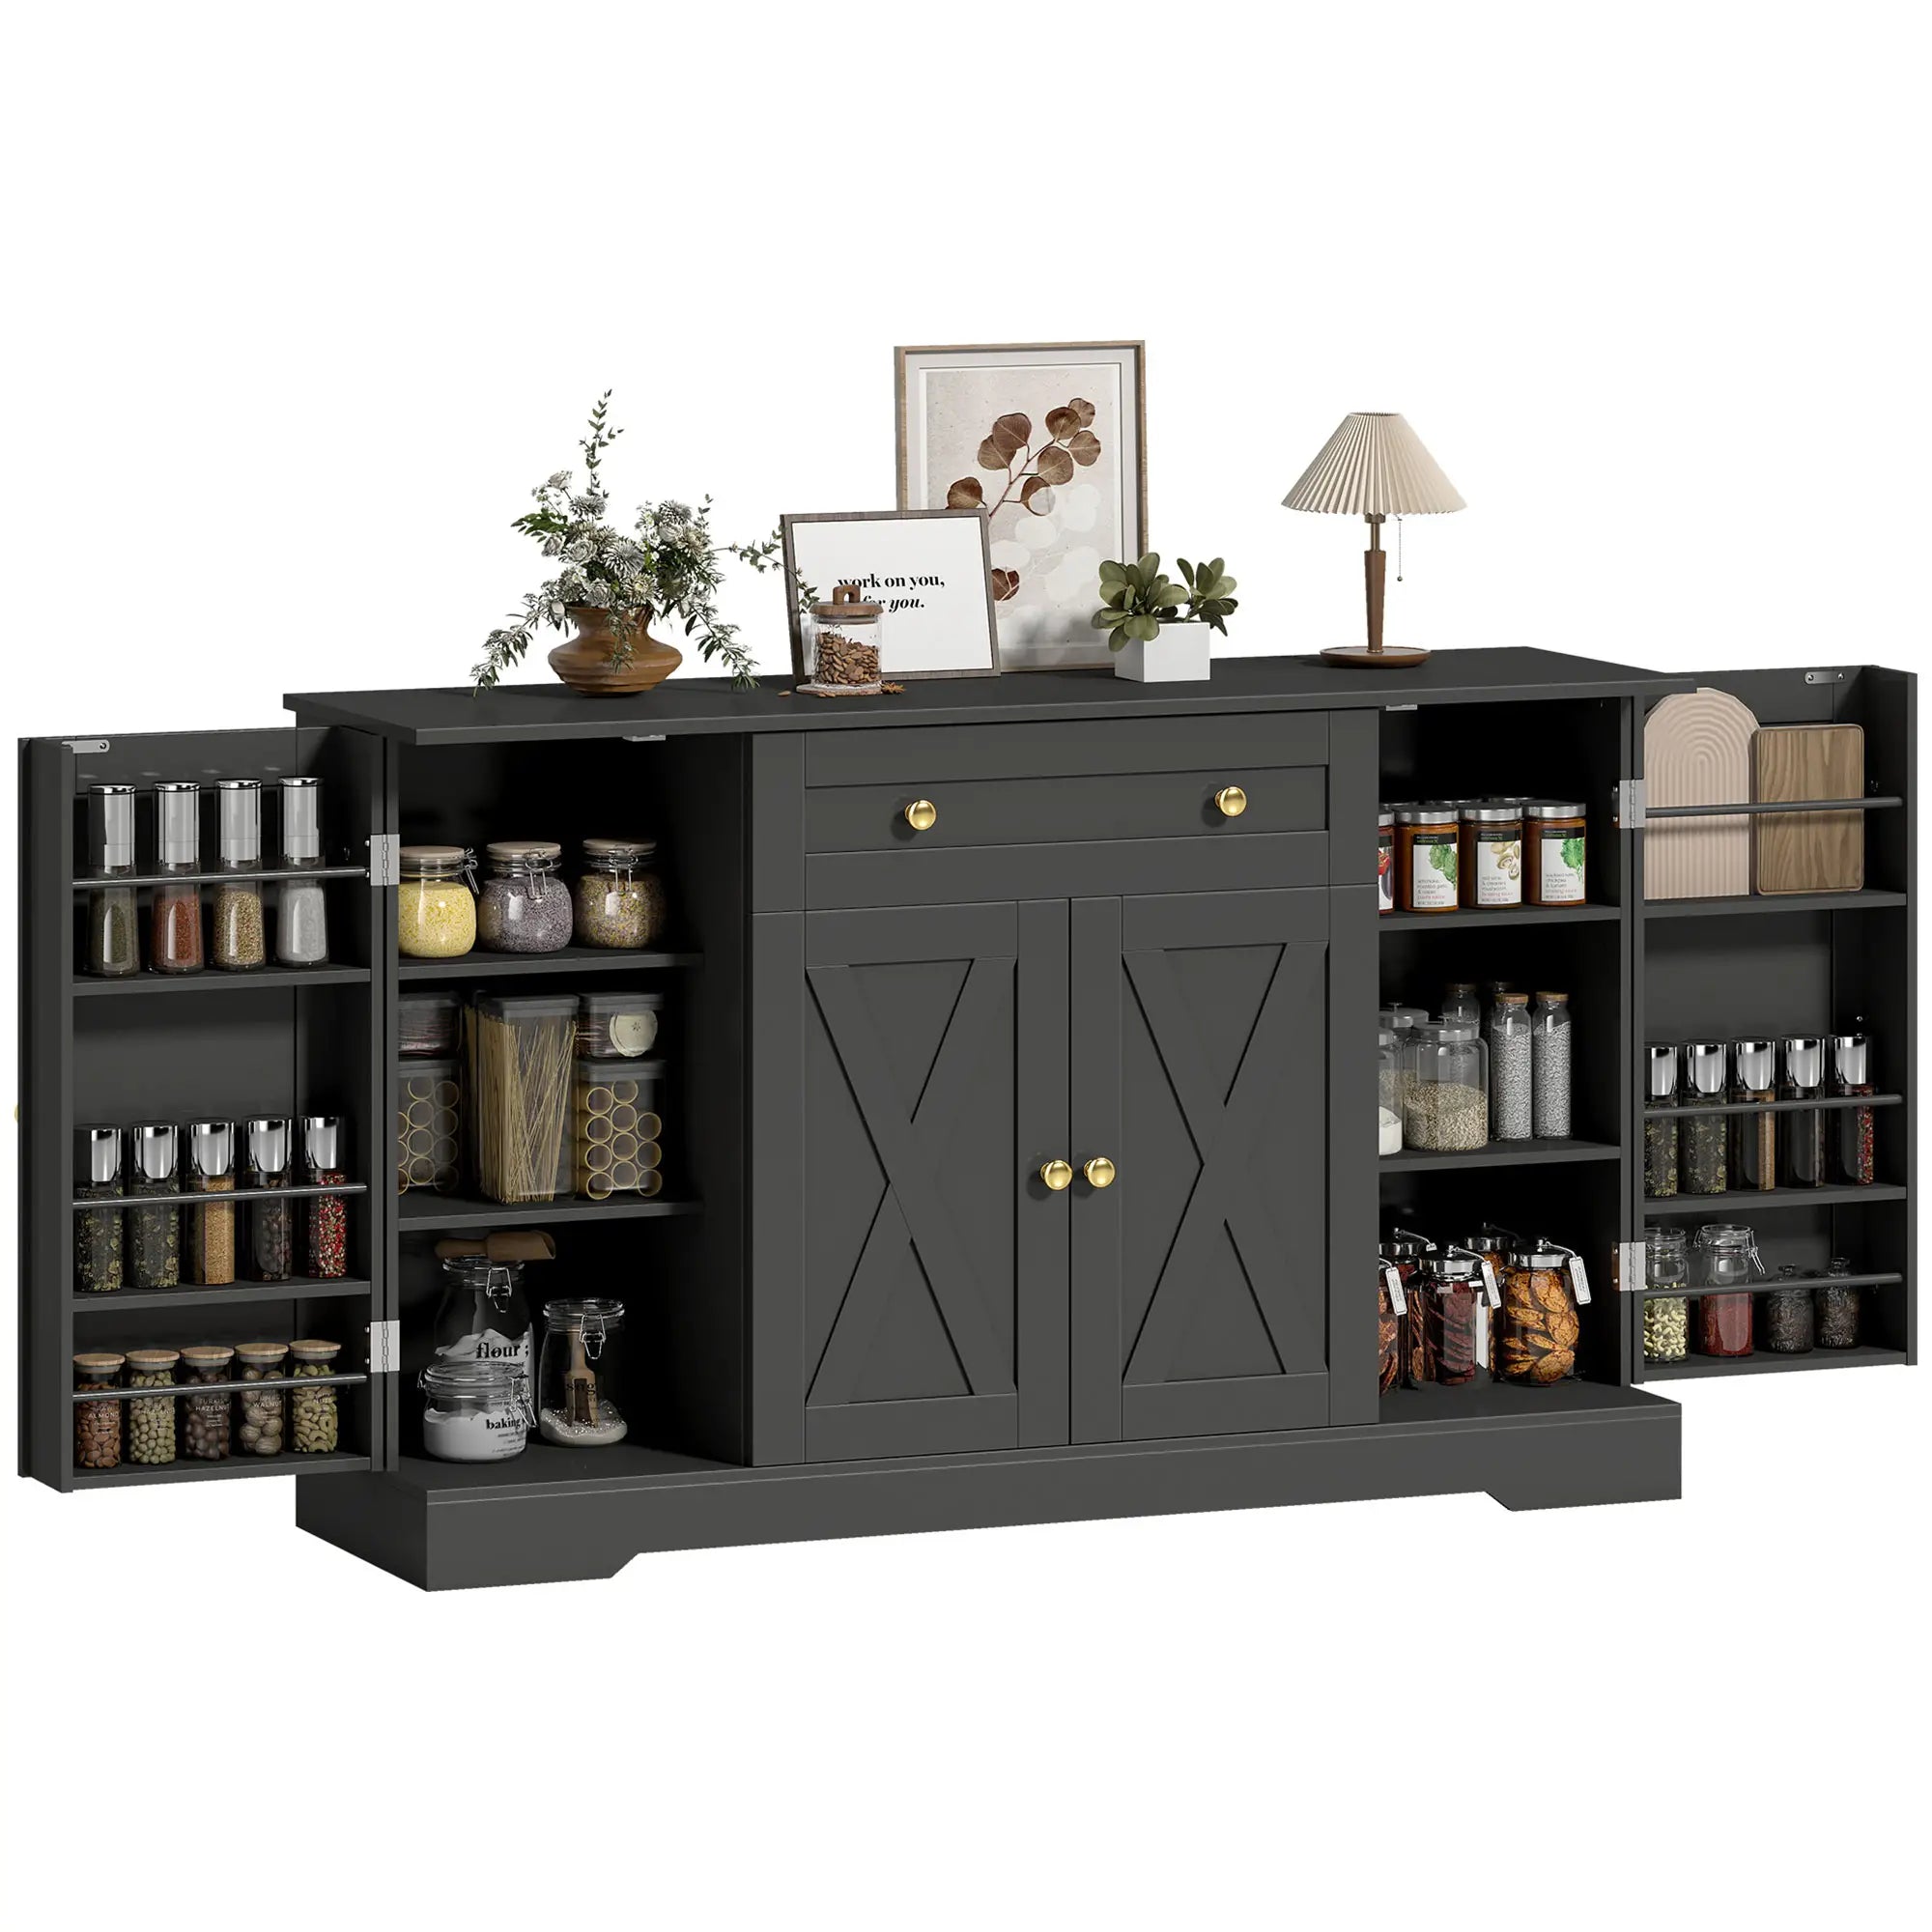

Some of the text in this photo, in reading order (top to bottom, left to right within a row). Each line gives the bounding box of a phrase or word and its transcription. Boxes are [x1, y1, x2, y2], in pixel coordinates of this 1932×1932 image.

[837, 573, 945, 591] work on you,
[888, 598, 924, 613] you.
[476, 1342, 521, 1359] flour
